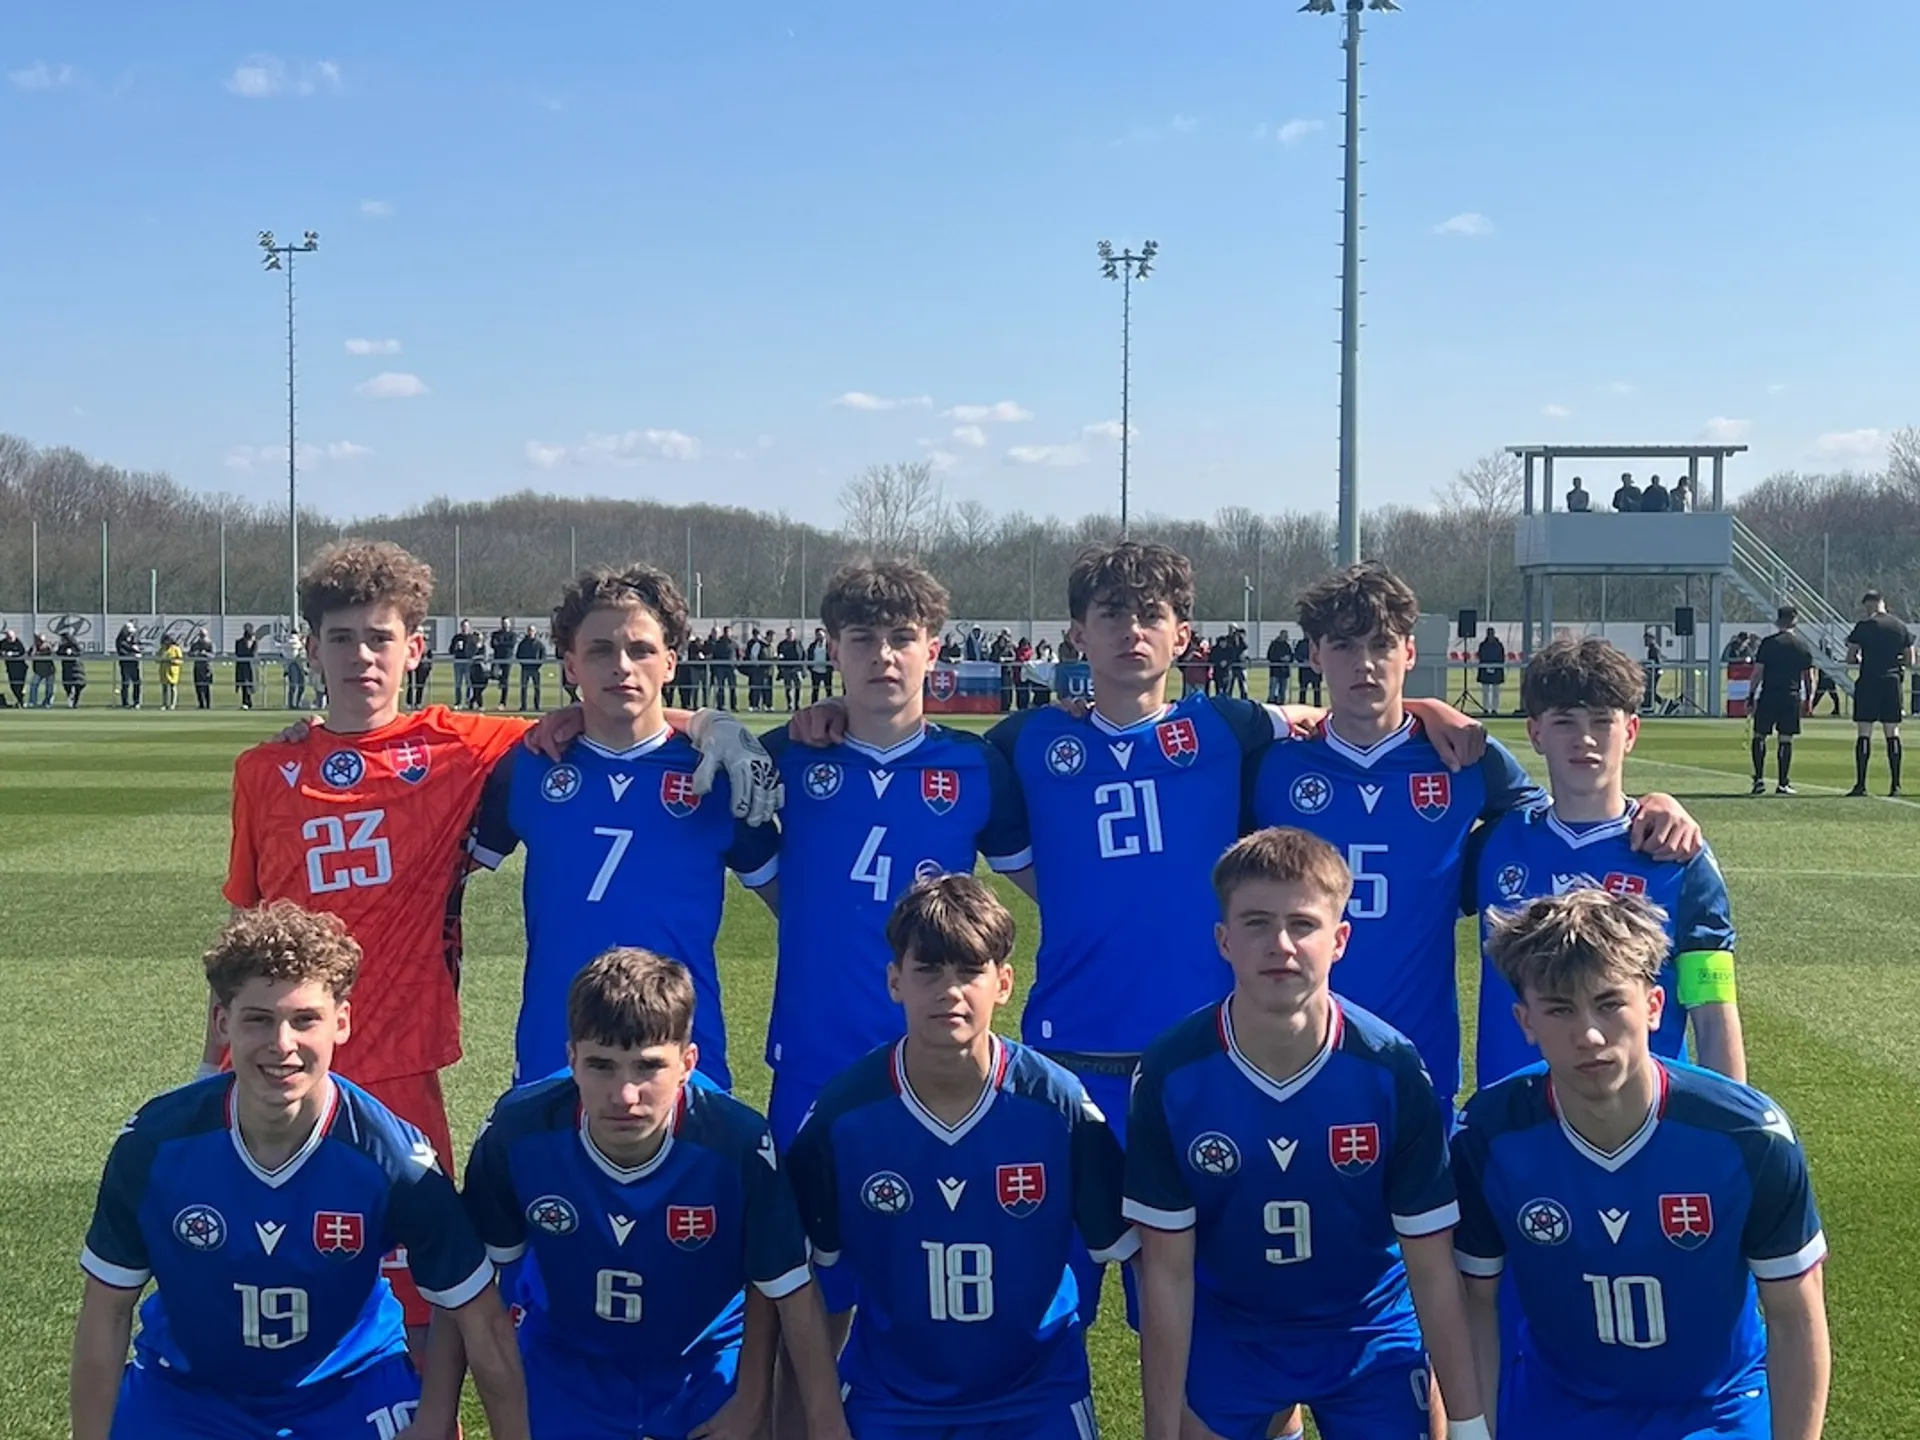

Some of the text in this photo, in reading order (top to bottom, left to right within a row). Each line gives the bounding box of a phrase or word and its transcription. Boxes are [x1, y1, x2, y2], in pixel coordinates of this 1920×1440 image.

[303, 809, 392, 893] 23
[1095, 779, 1163, 857] 21
[587, 827, 633, 901] 7
[850, 826, 891, 901] 4
[1347, 844, 1388, 918] 5
[1264, 1200, 1311, 1264] 9
[233, 1283, 308, 1348] 19
[596, 1269, 643, 1323] 6
[921, 1240, 993, 1321] 18
[1583, 1273, 1666, 1348] 10
